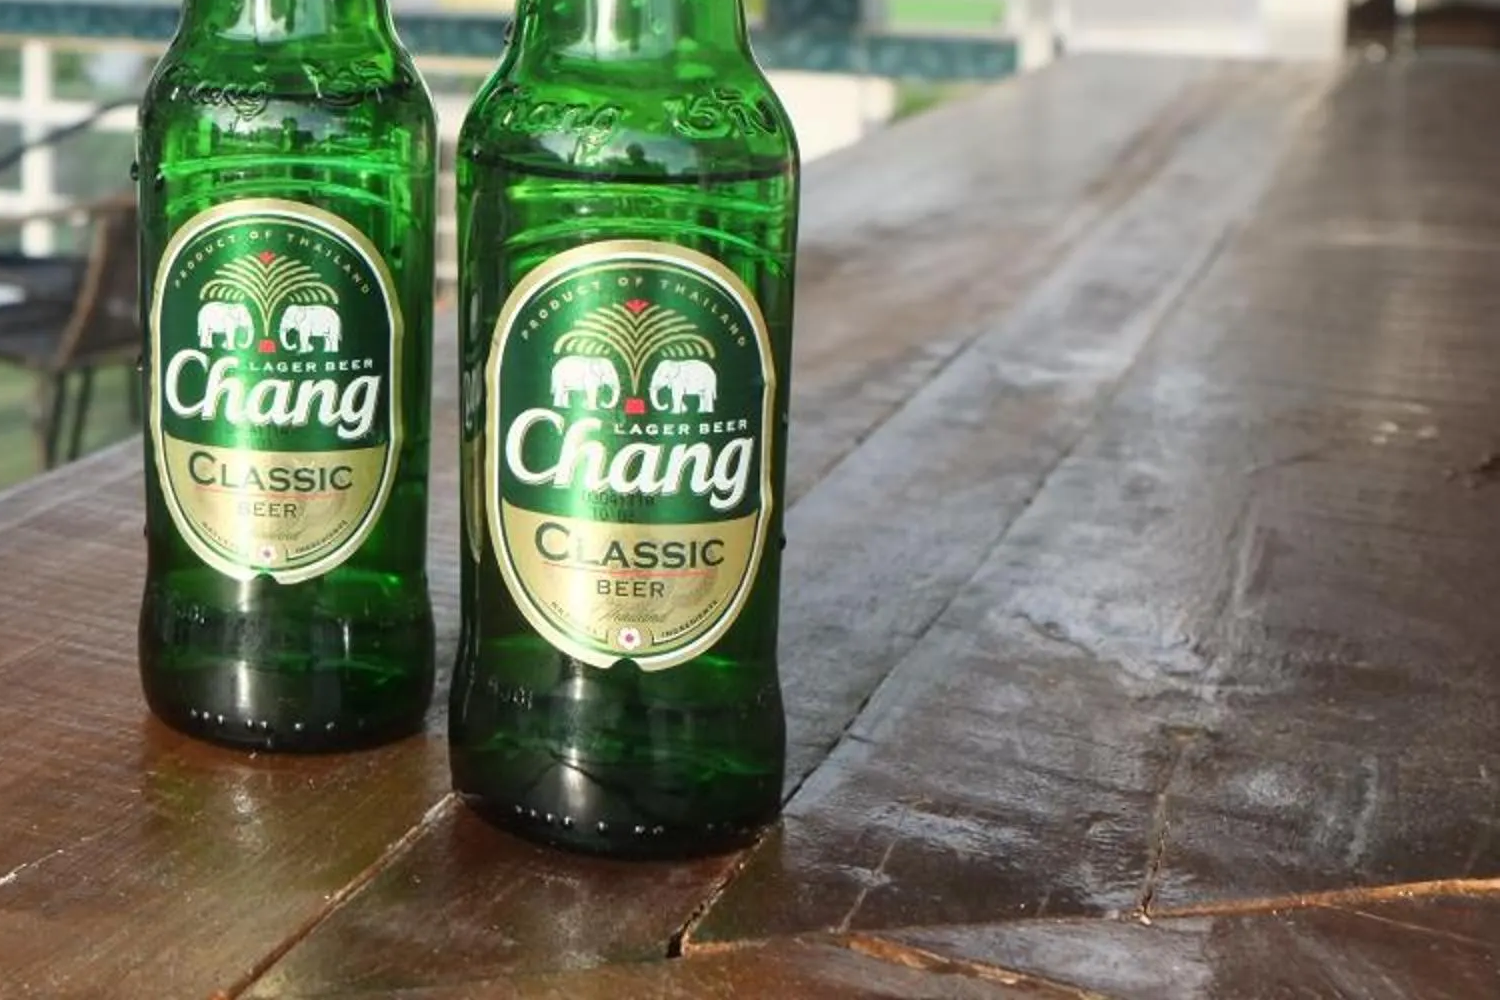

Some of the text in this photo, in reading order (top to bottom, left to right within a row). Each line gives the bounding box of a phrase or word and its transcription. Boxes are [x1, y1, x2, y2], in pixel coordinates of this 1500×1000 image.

[174, 230, 371, 295] PRODUCT OF THAILAND
[520, 275, 746, 347] PRODUCT OF THAILAND
[249, 357, 374, 373] LAGER BEER
[164, 348, 383, 440] Chang
[613, 418, 748, 436] LAGER BEER
[187, 450, 354, 493] CLASSIC
[504, 406, 755, 511] Chang
[238, 501, 298, 519] BEER
[534, 520, 726, 570] CLASSIC
[596, 578, 666, 599] BEER
